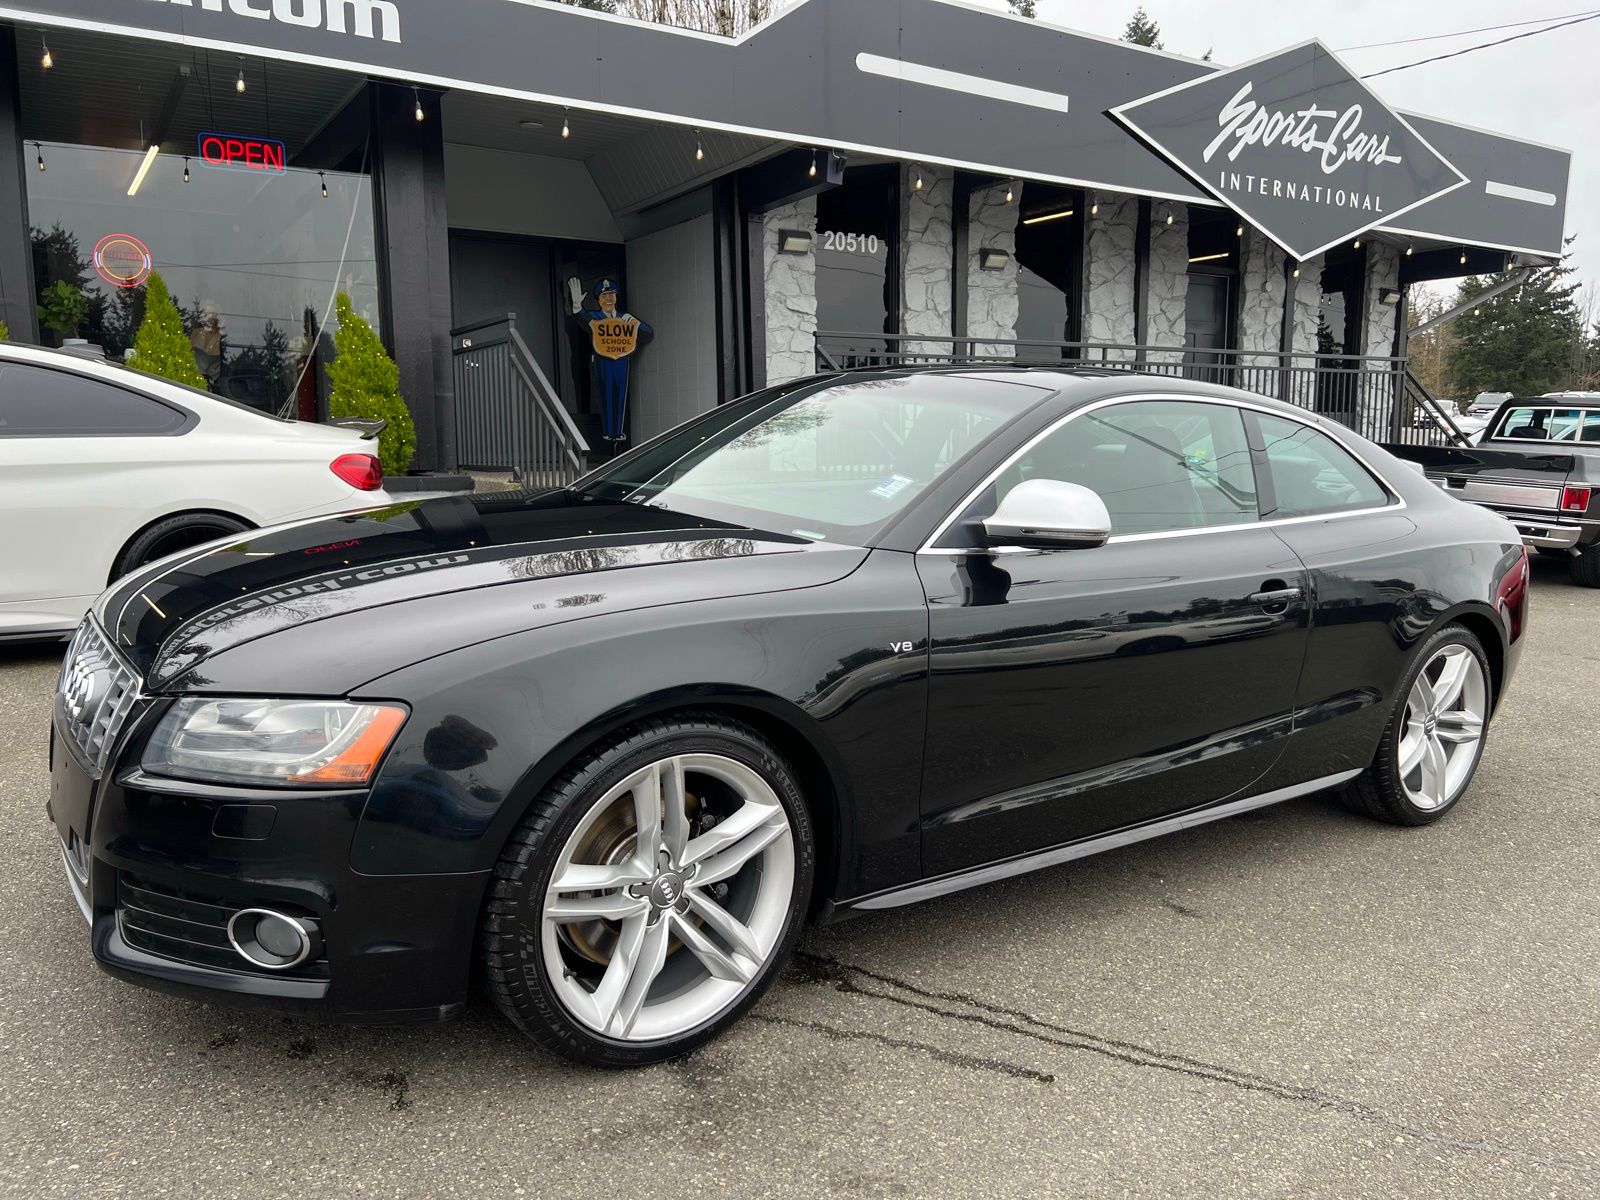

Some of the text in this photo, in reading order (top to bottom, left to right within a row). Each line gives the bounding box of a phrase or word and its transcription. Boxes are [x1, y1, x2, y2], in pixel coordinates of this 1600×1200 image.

[1203, 80, 1402, 175] Sports Cars
[203, 137, 283, 171] OPEN
[1219, 171, 1383, 213] INTERNATIONAL
[824, 230, 878, 254] 20510
[598, 324, 634, 337] SLOW
[890, 641, 913, 653] V8
